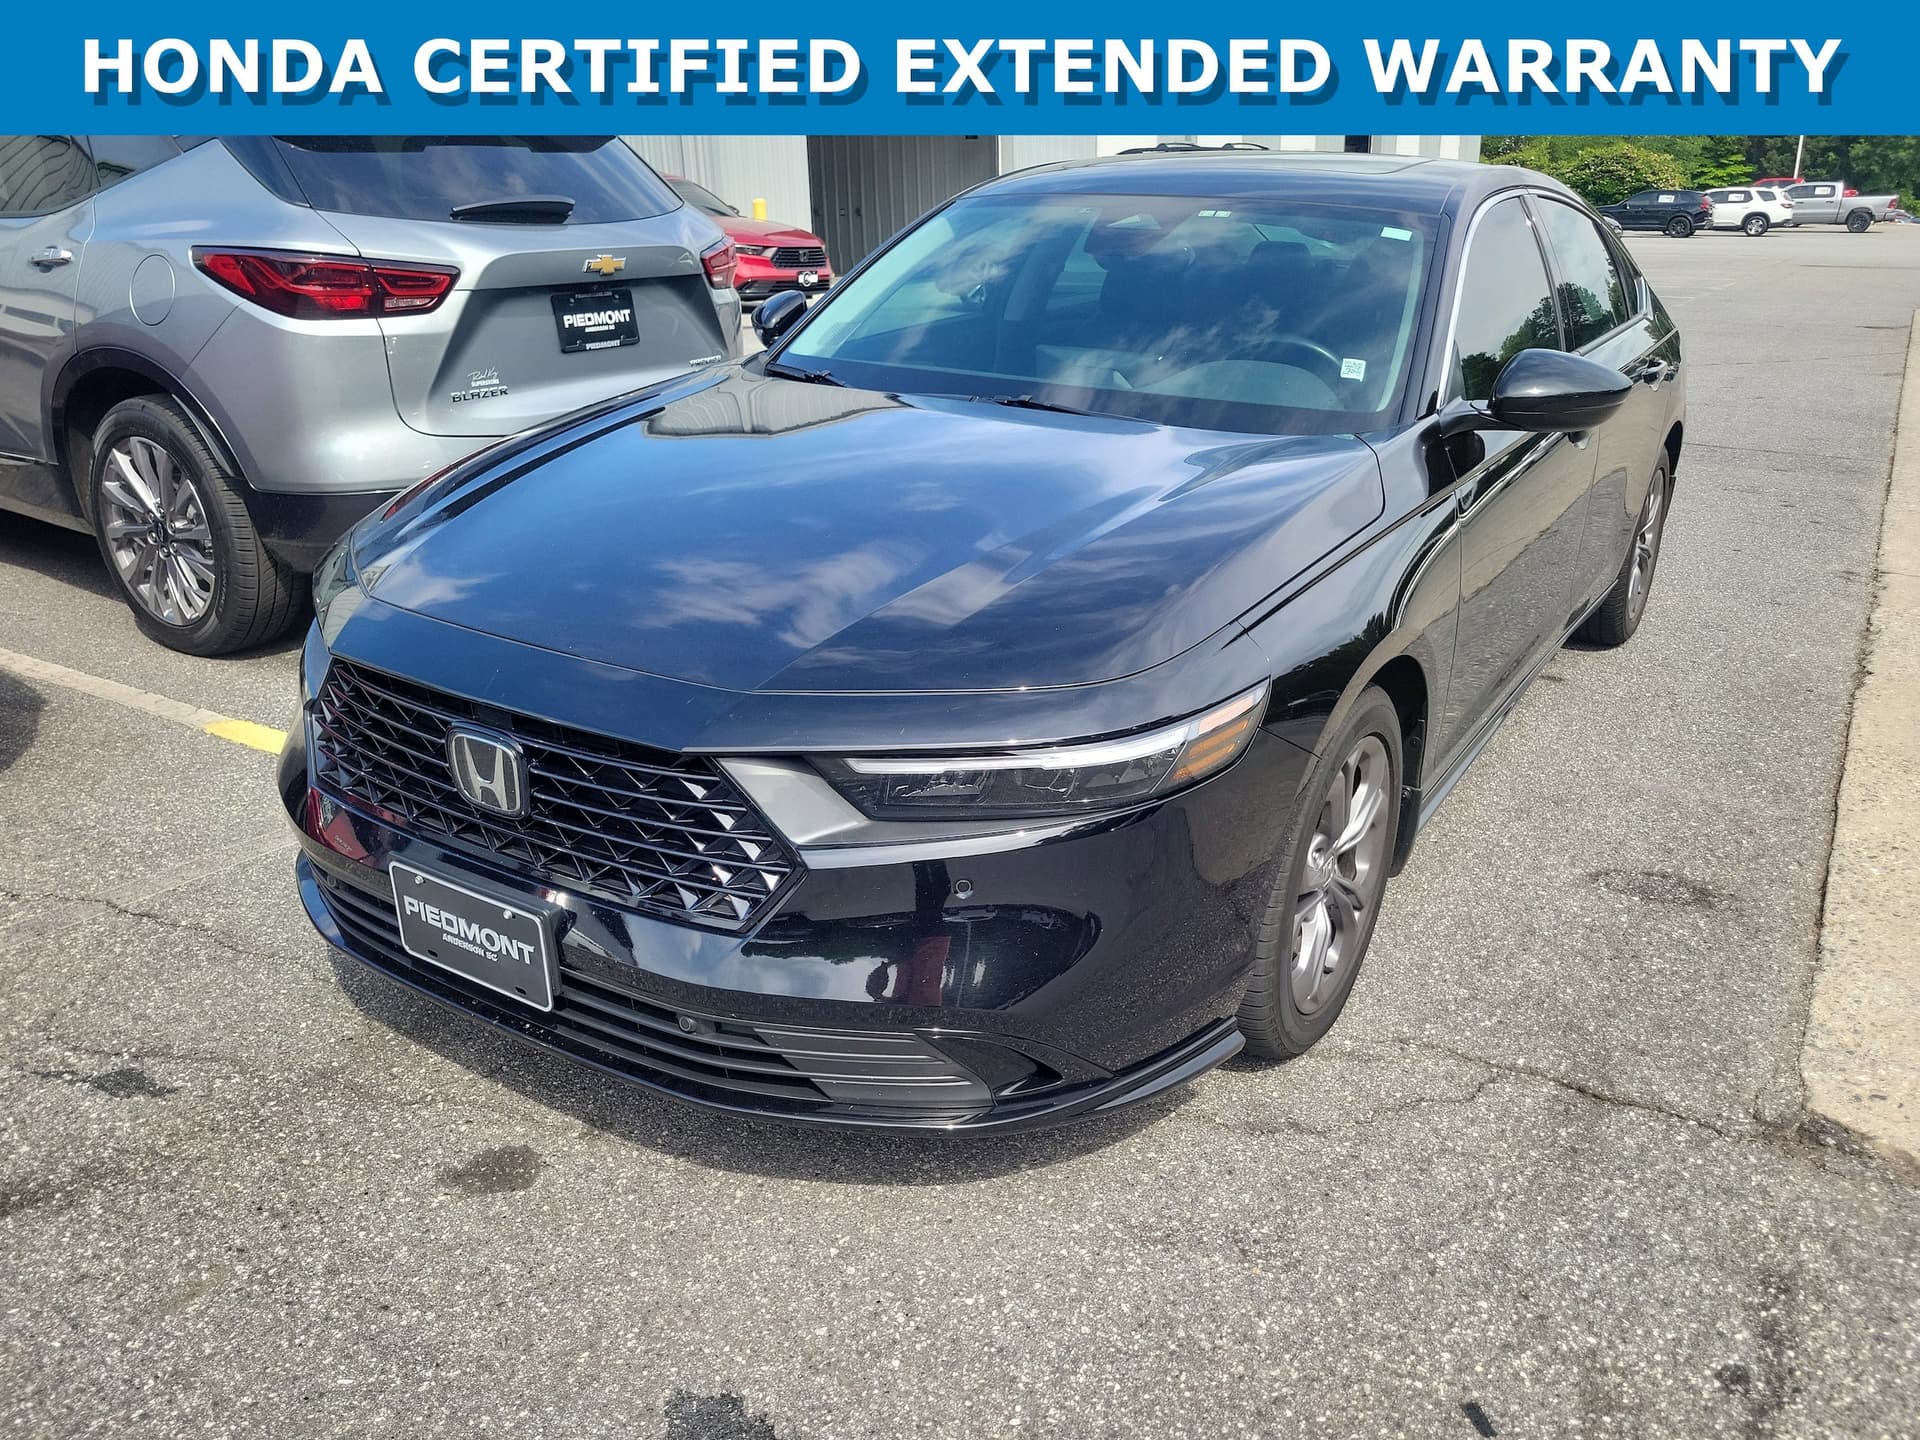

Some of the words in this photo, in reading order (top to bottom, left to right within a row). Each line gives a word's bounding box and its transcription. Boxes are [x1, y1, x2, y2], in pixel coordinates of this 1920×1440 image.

[563, 309, 631, 328] PIEDMONT
[450, 386, 509, 403] BLAZER
[403, 895, 536, 965] PIEDMONT
[442, 933, 486, 957] ANDERSON
[485, 951, 498, 962] SC
